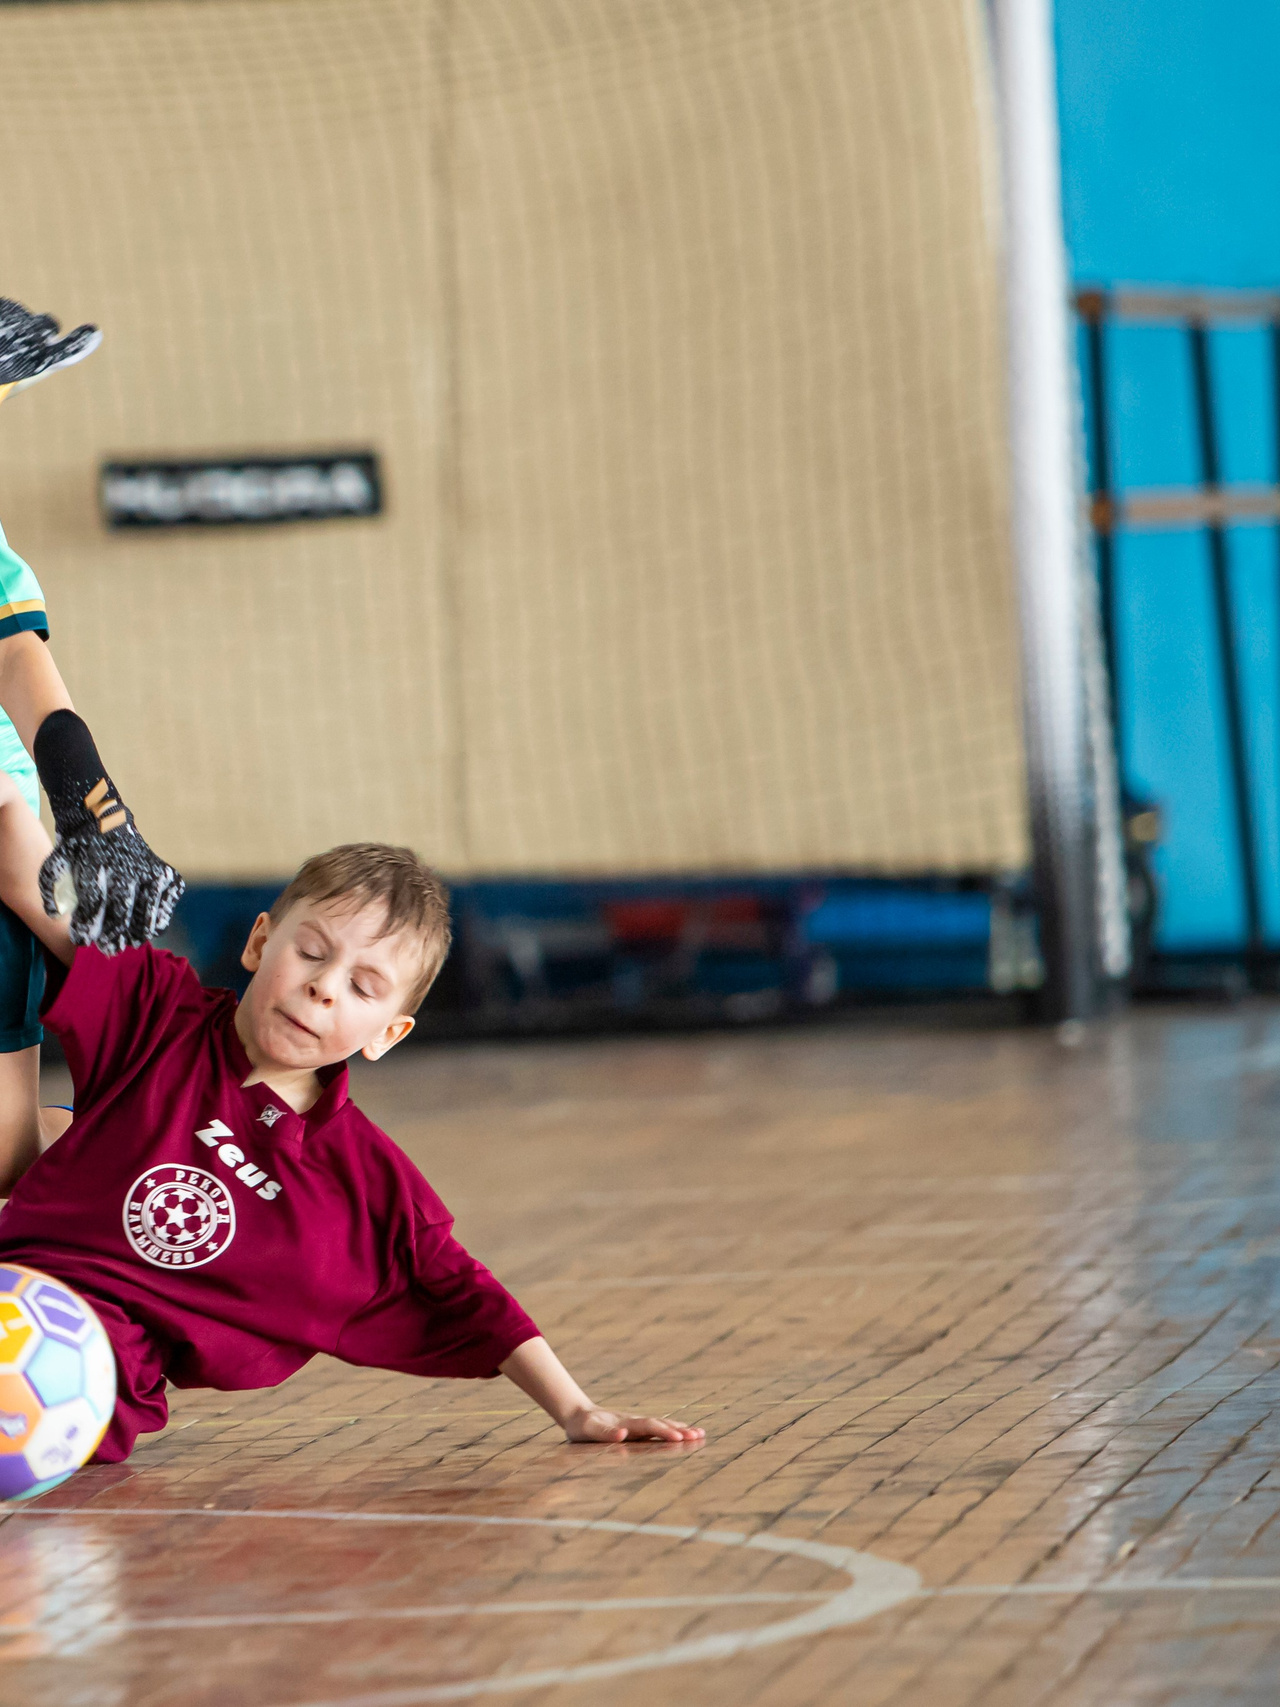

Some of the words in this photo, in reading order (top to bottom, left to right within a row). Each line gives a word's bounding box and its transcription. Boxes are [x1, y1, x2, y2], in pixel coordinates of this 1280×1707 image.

[195, 1119, 282, 1201] Zeus
[175, 1170, 230, 1224] РЕКОРД
[129, 1201, 195, 1264] БАРЫШЕВО
